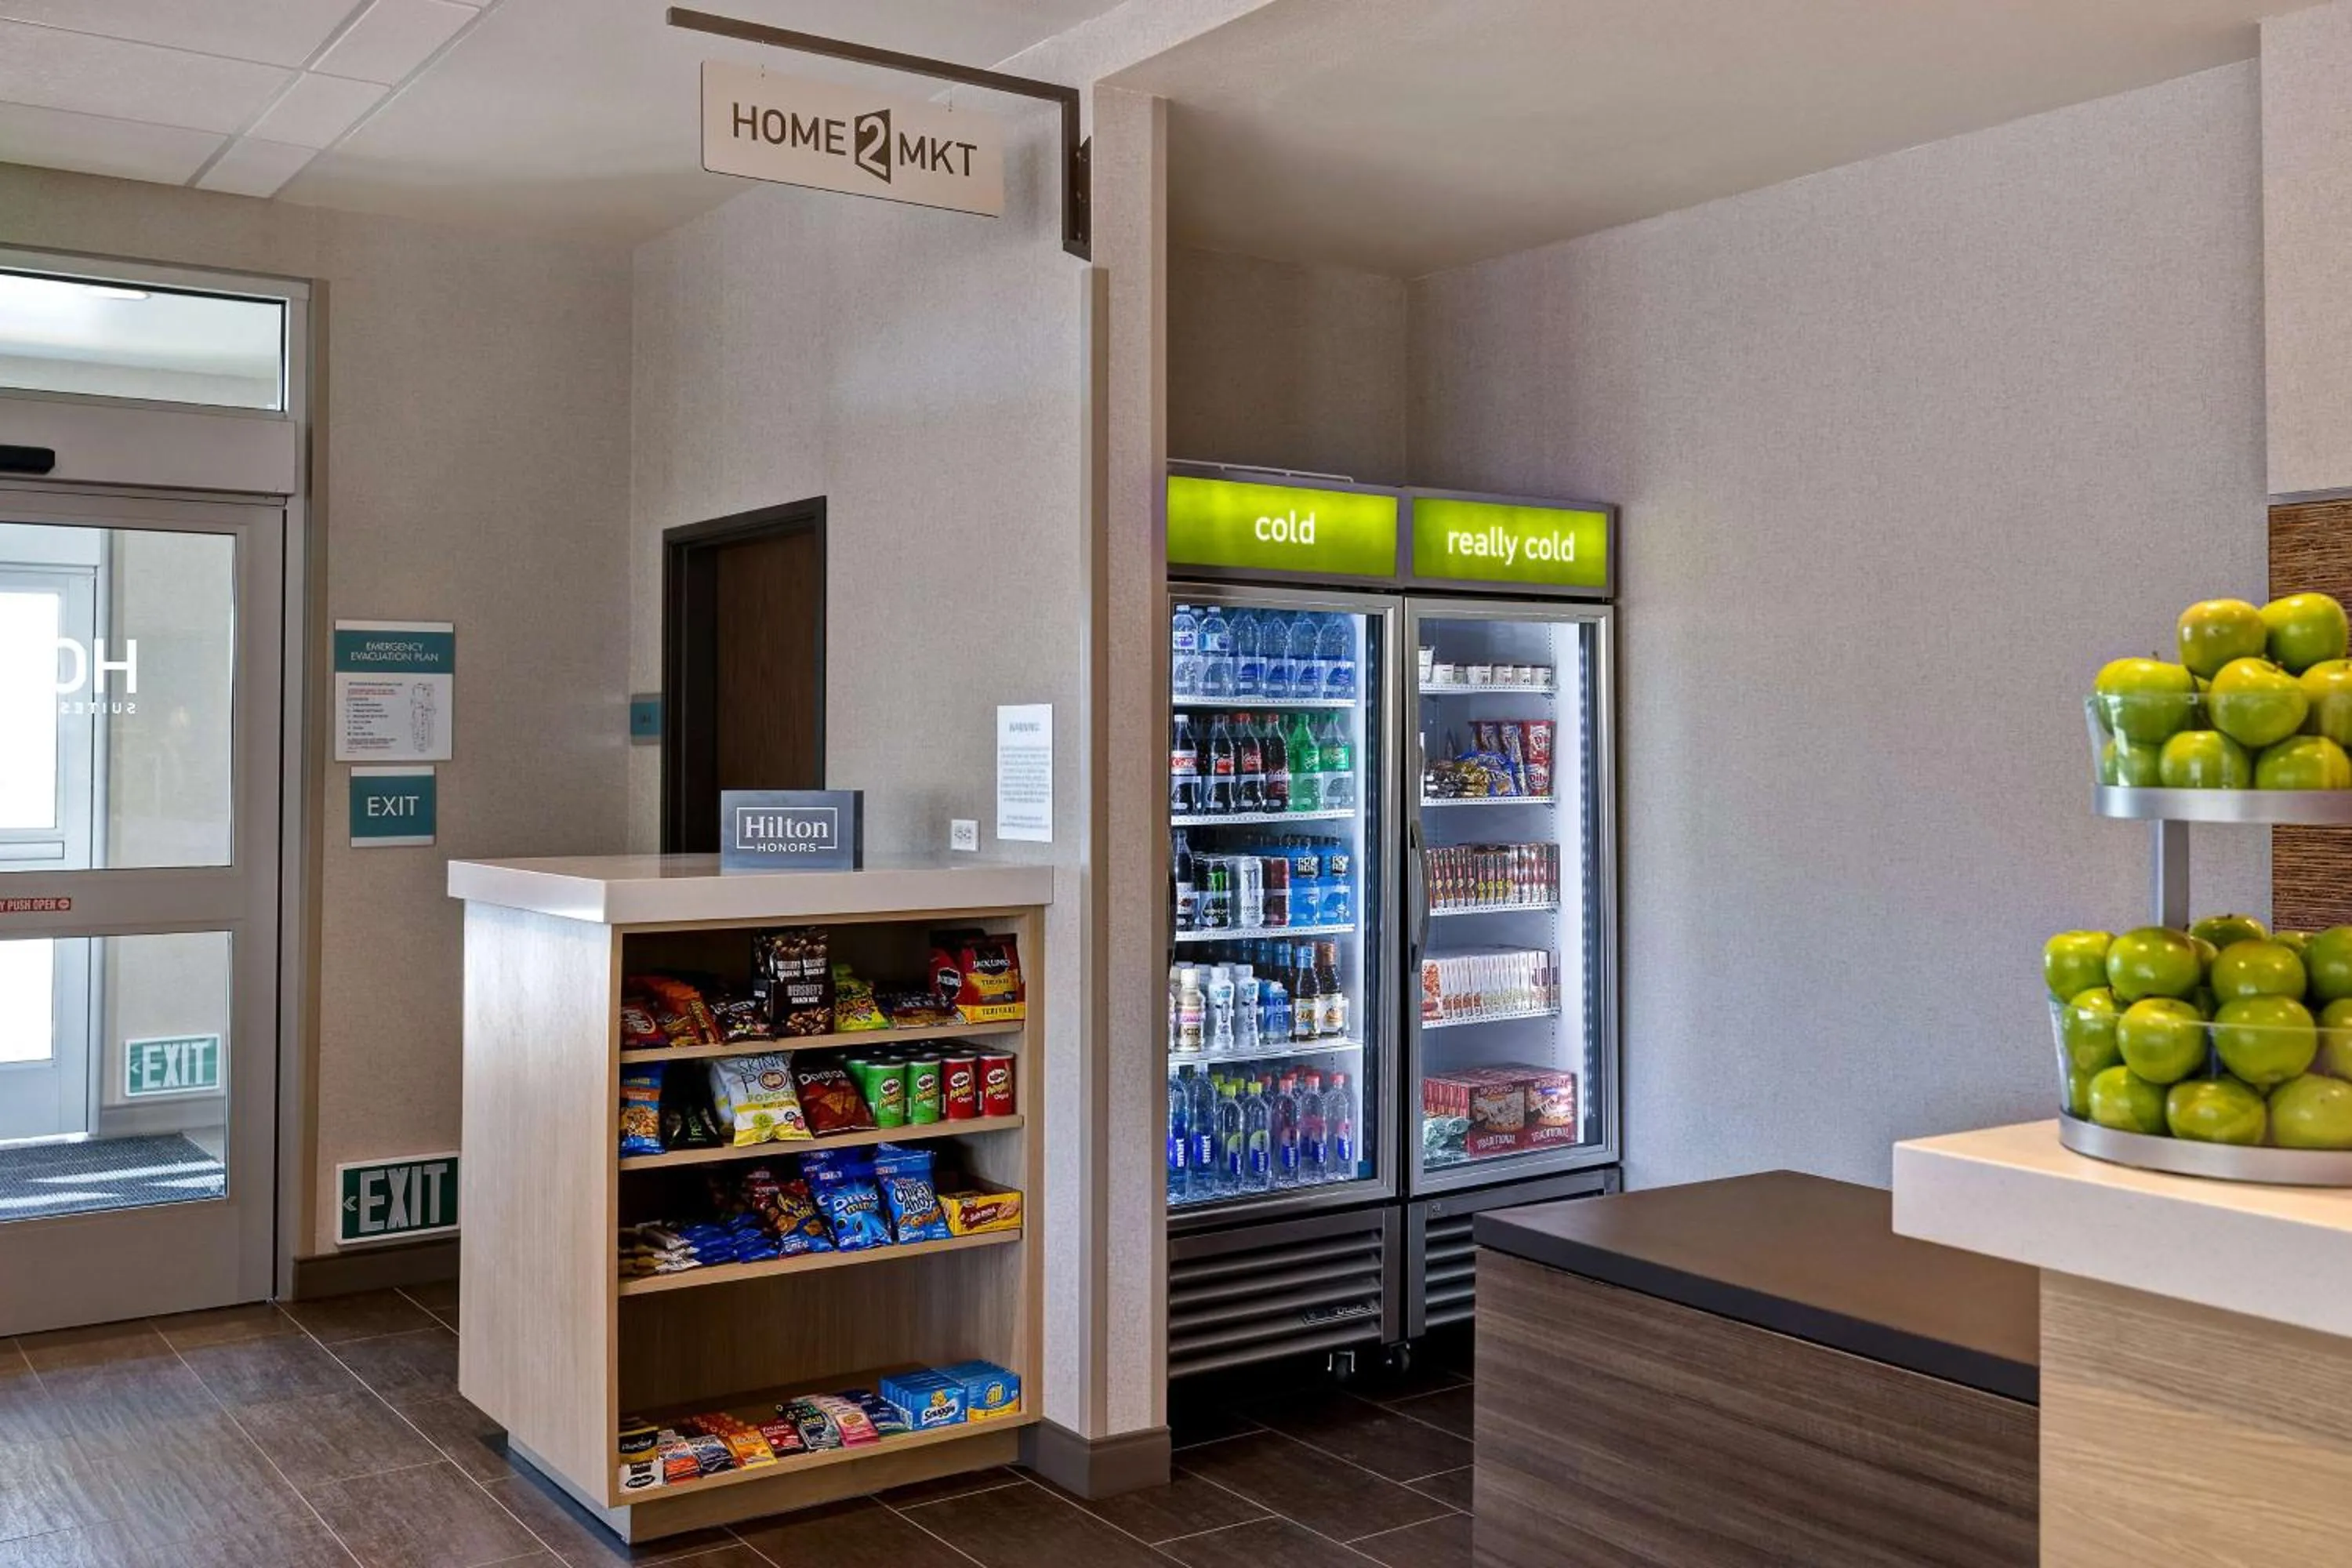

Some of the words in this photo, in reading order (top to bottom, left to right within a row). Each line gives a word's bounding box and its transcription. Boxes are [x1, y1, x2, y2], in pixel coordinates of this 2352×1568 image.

[1254, 512, 1316, 545] cold
[1446, 526, 1519, 565] really
[1524, 532, 1575, 562] cold
[350, 652, 412, 662] EVACUATION
[414, 652, 439, 662] PLAN
[365, 641, 424, 652] EMERGENCY
[367, 796, 419, 817] EXIT
[745, 815, 829, 839] Hilton
[757, 843, 817, 853] HONORS
[7, 899, 31, 910] PUSH
[33, 898, 56, 909] OPEN
[142, 1040, 211, 1090] EXIT
[358, 1163, 448, 1233] EXIT
